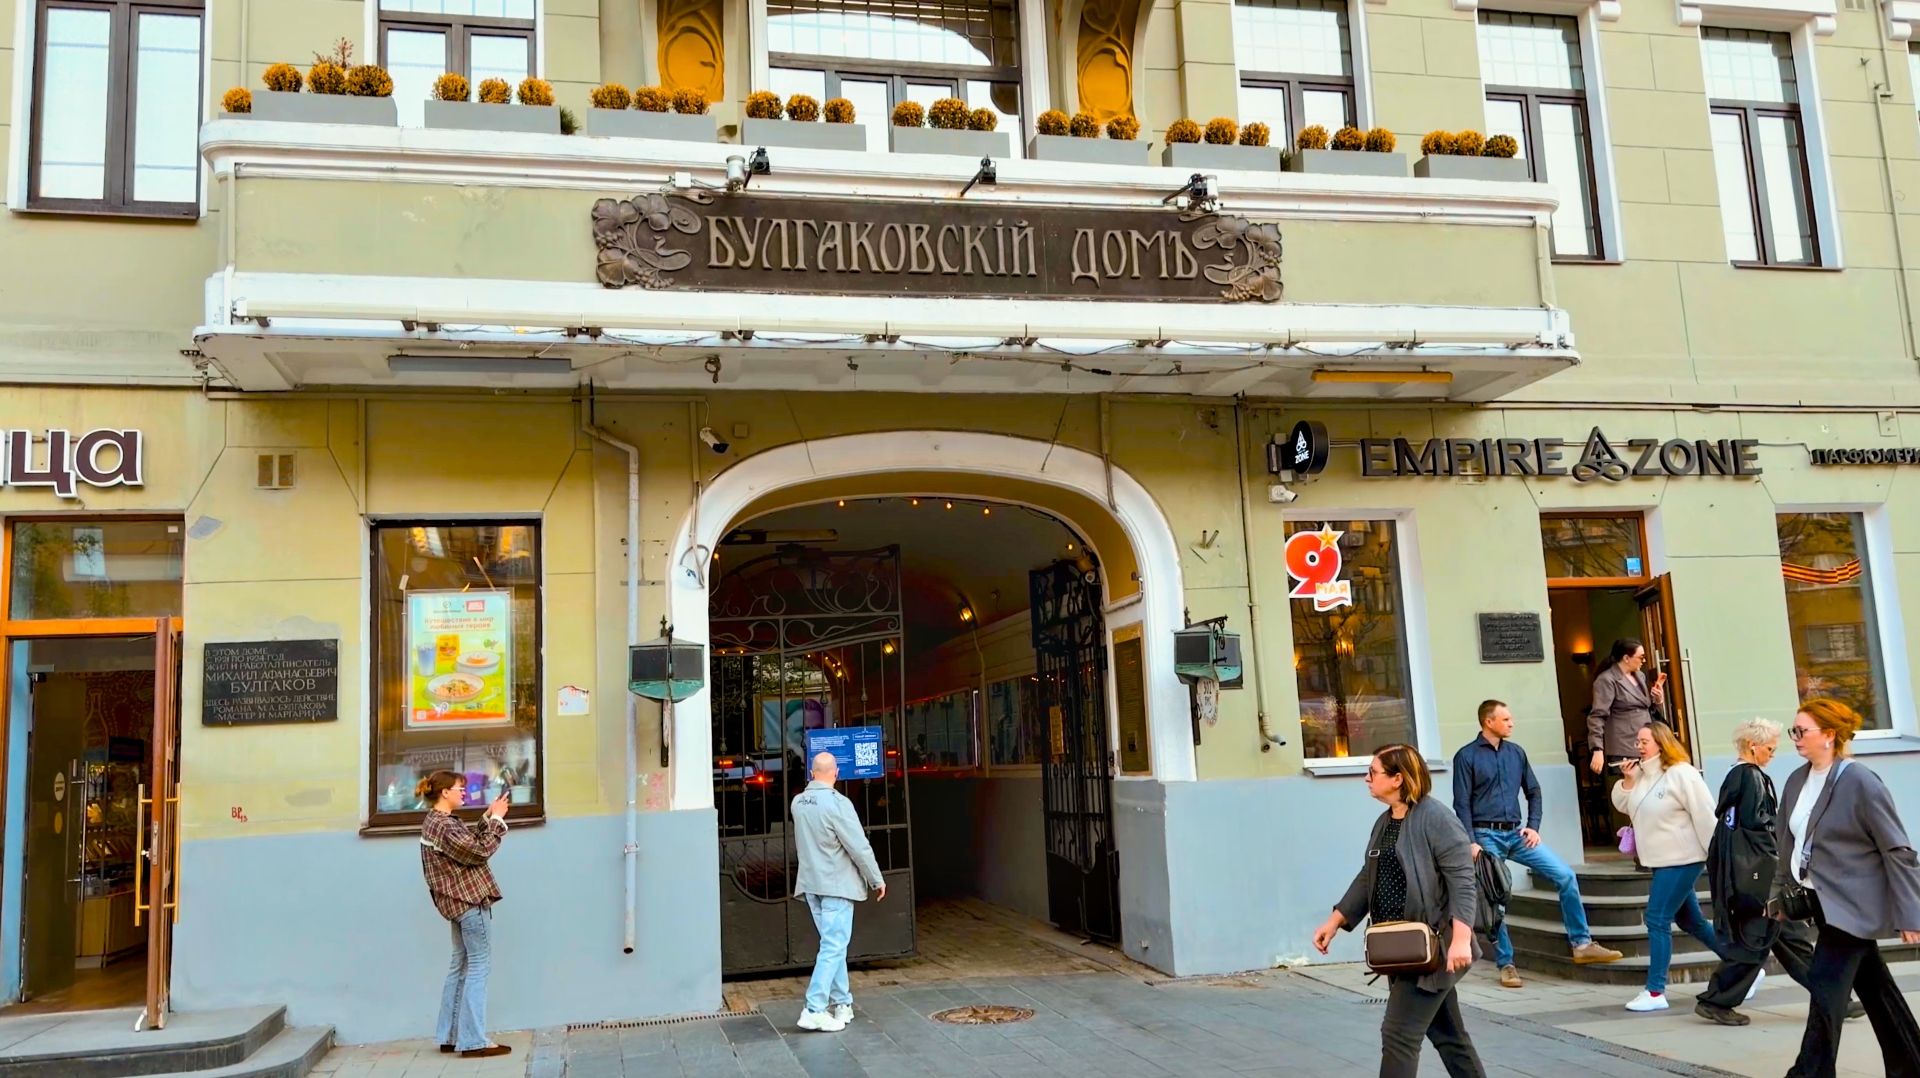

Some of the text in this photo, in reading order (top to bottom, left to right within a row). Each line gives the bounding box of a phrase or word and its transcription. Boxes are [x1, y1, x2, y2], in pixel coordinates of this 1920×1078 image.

[704, 215, 1199, 288] БУЛГАКОВСКІЙ ДОМЪ
[0, 428, 144, 498] ца
[1295, 450, 1310, 464] ZONE
[1360, 437, 1763, 477] EMPIRE ZONE
[1286, 531, 1342, 597] 9
[1316, 582, 1349, 595] МАЯ
[205, 667, 337, 681] МИХАИЛ АФАНАСЬЕВИЧ
[230, 678, 316, 694] БУЛГАКОВ
